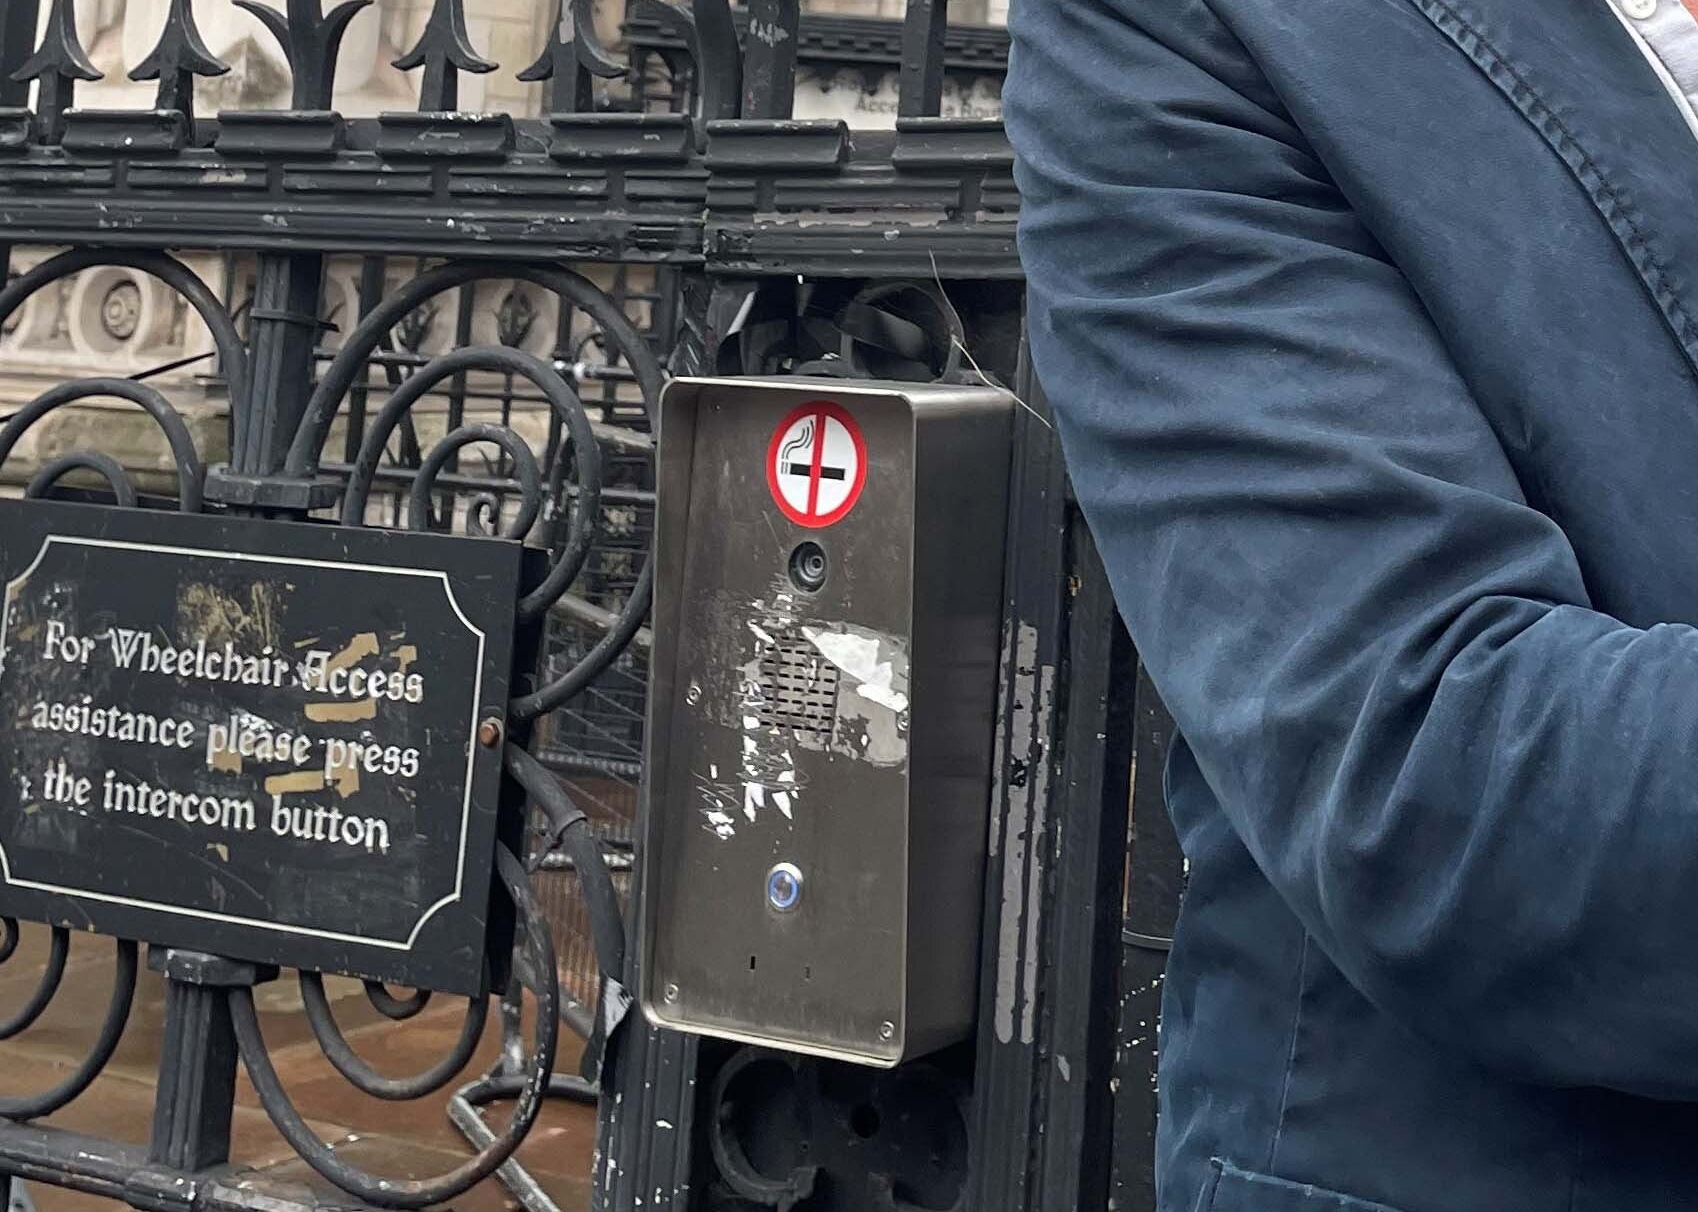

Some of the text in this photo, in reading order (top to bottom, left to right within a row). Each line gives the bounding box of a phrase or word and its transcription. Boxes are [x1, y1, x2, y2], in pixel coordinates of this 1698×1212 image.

[43, 619, 424, 703] For Wheelchair Access
[31, 695, 419, 782] assistance please press
[44, 757, 391, 852] the intercom button
